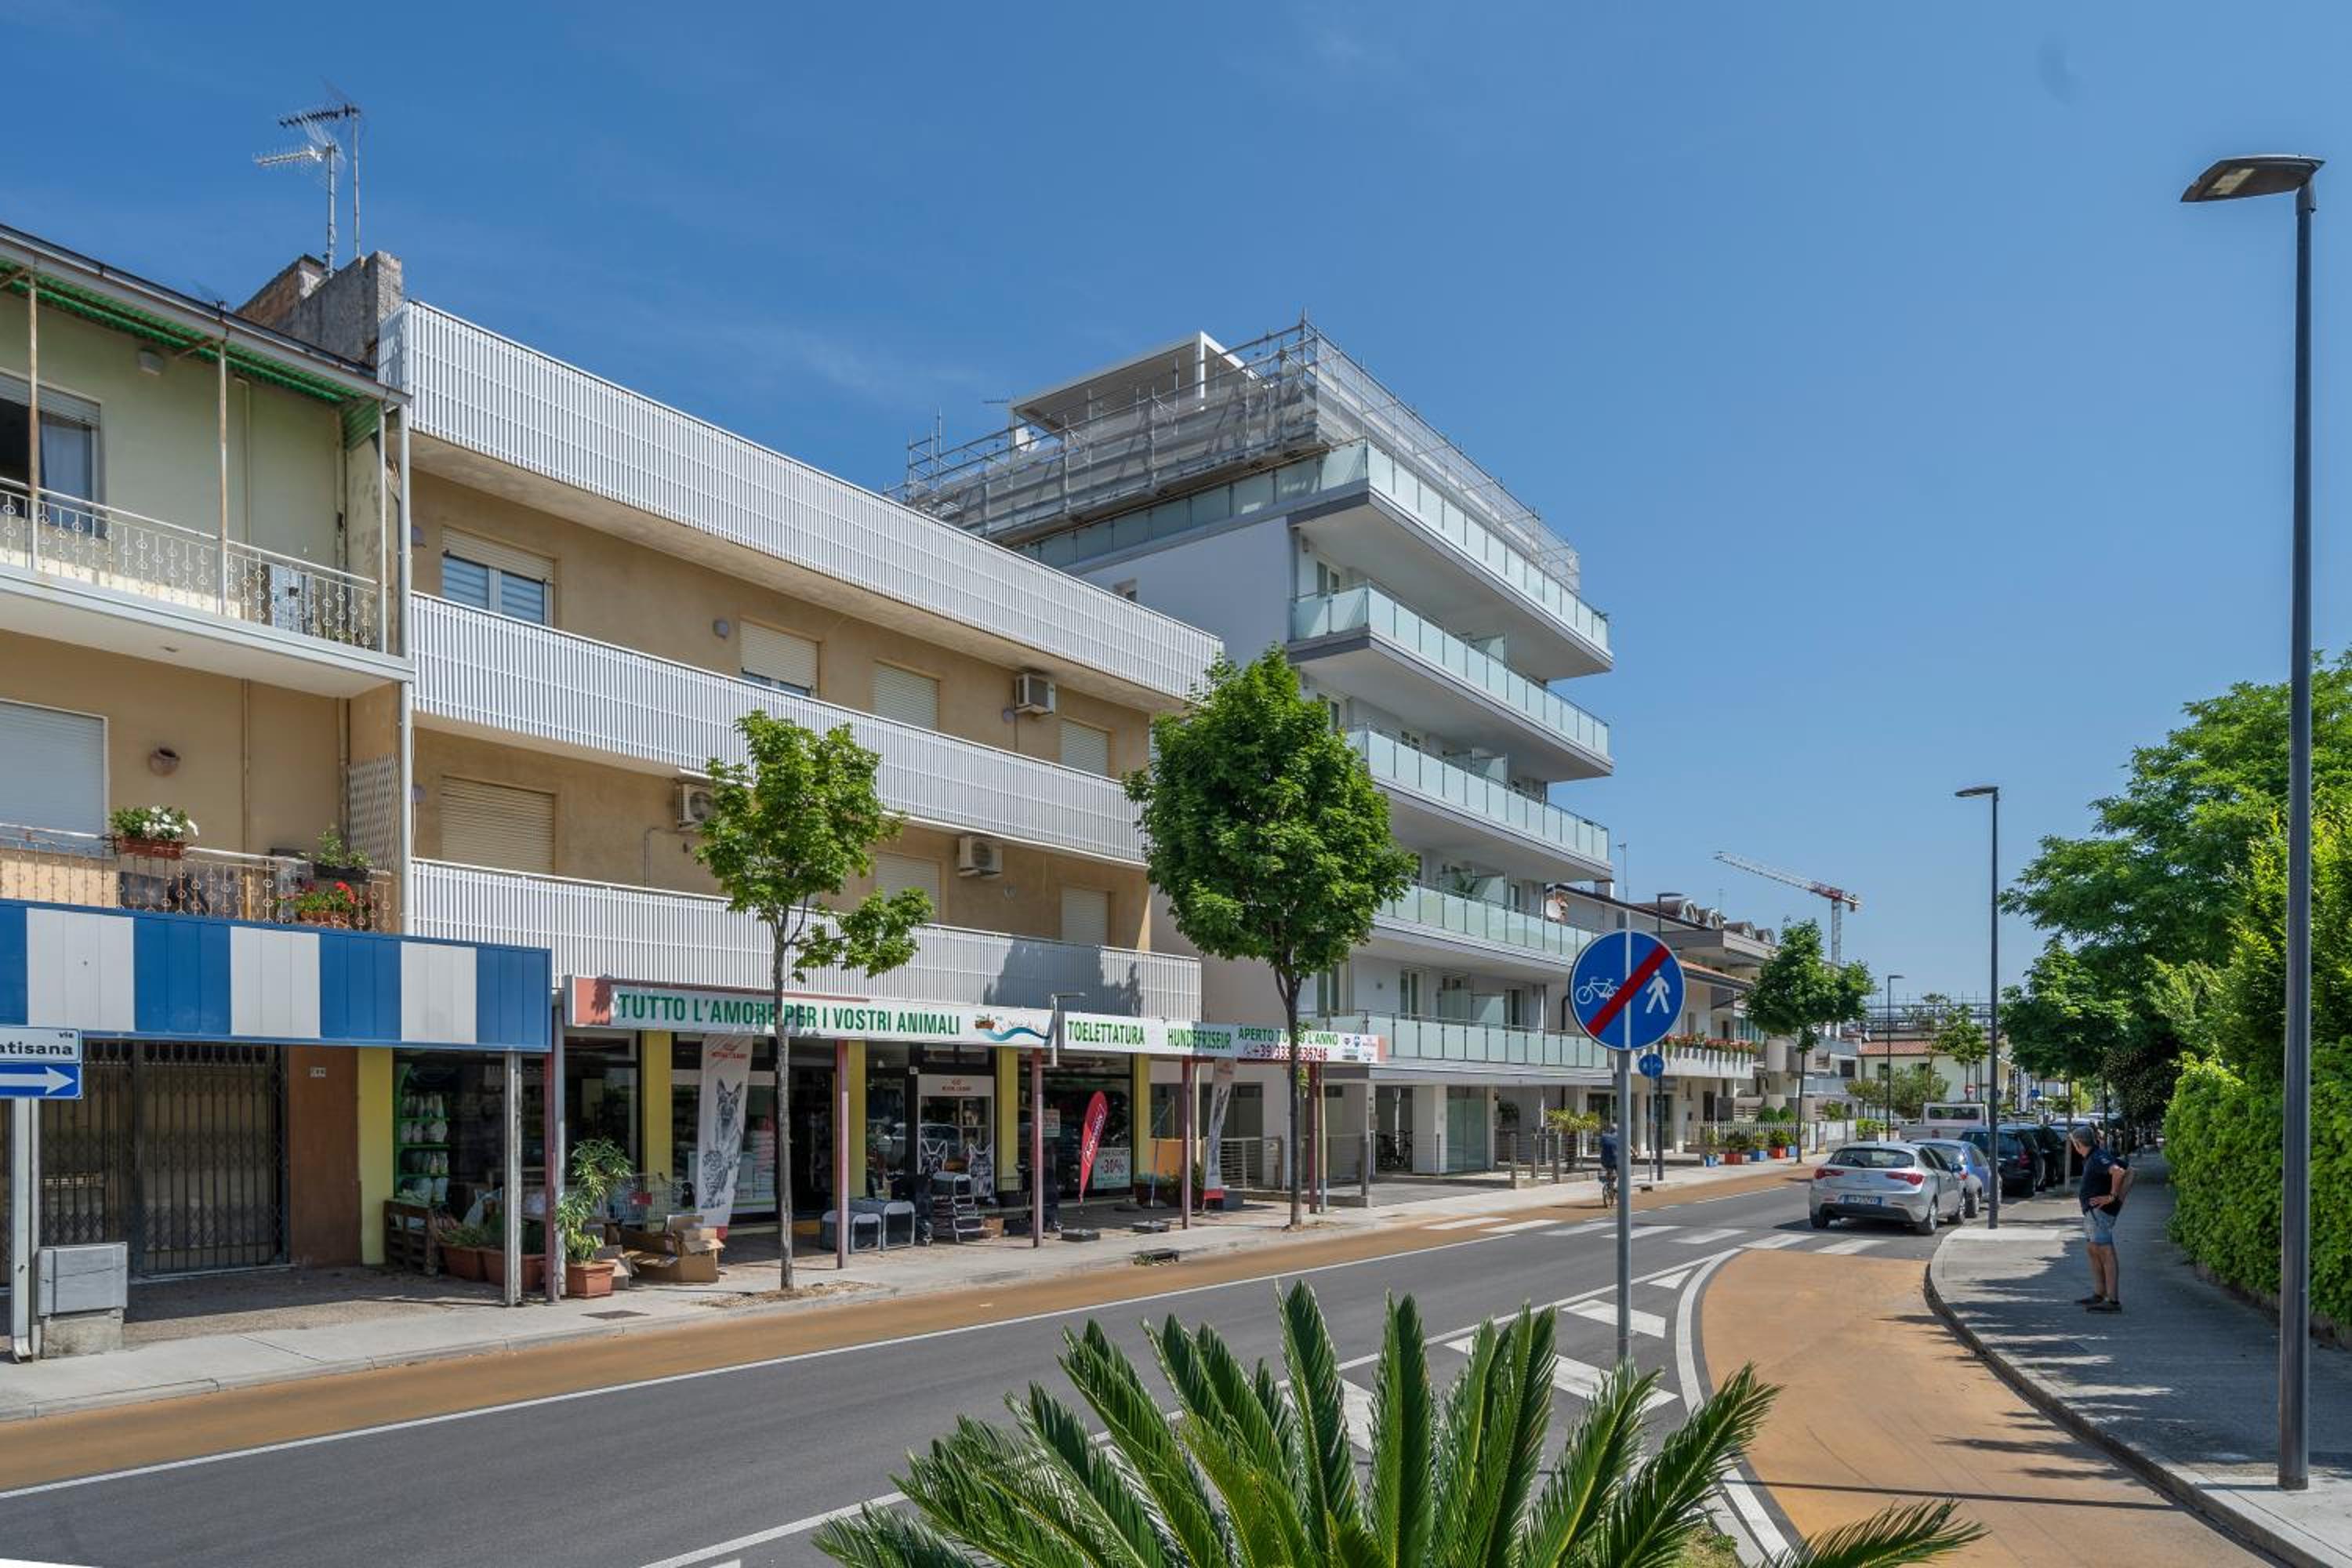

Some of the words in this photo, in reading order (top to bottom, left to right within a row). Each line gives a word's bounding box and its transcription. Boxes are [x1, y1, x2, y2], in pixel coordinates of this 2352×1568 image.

[618, 993, 686, 1021] TUTTO
[694, 998, 775, 1027] L'AMORE
[784, 1004, 817, 1029] PER
[822, 1007, 828, 1029] I
[833, 1007, 891, 1032] VOSTRI
[896, 1011, 960, 1036] ANIMALI
[1067, 1020, 1145, 1045] TOELETTATURA
[1167, 1028, 1232, 1051] HUNDEFRISEUR
[1237, 1027, 1274, 1042] APERTO
[1276, 1029, 1305, 1044] TUO
[1308, 1032, 1338, 1046] L'ANNO
